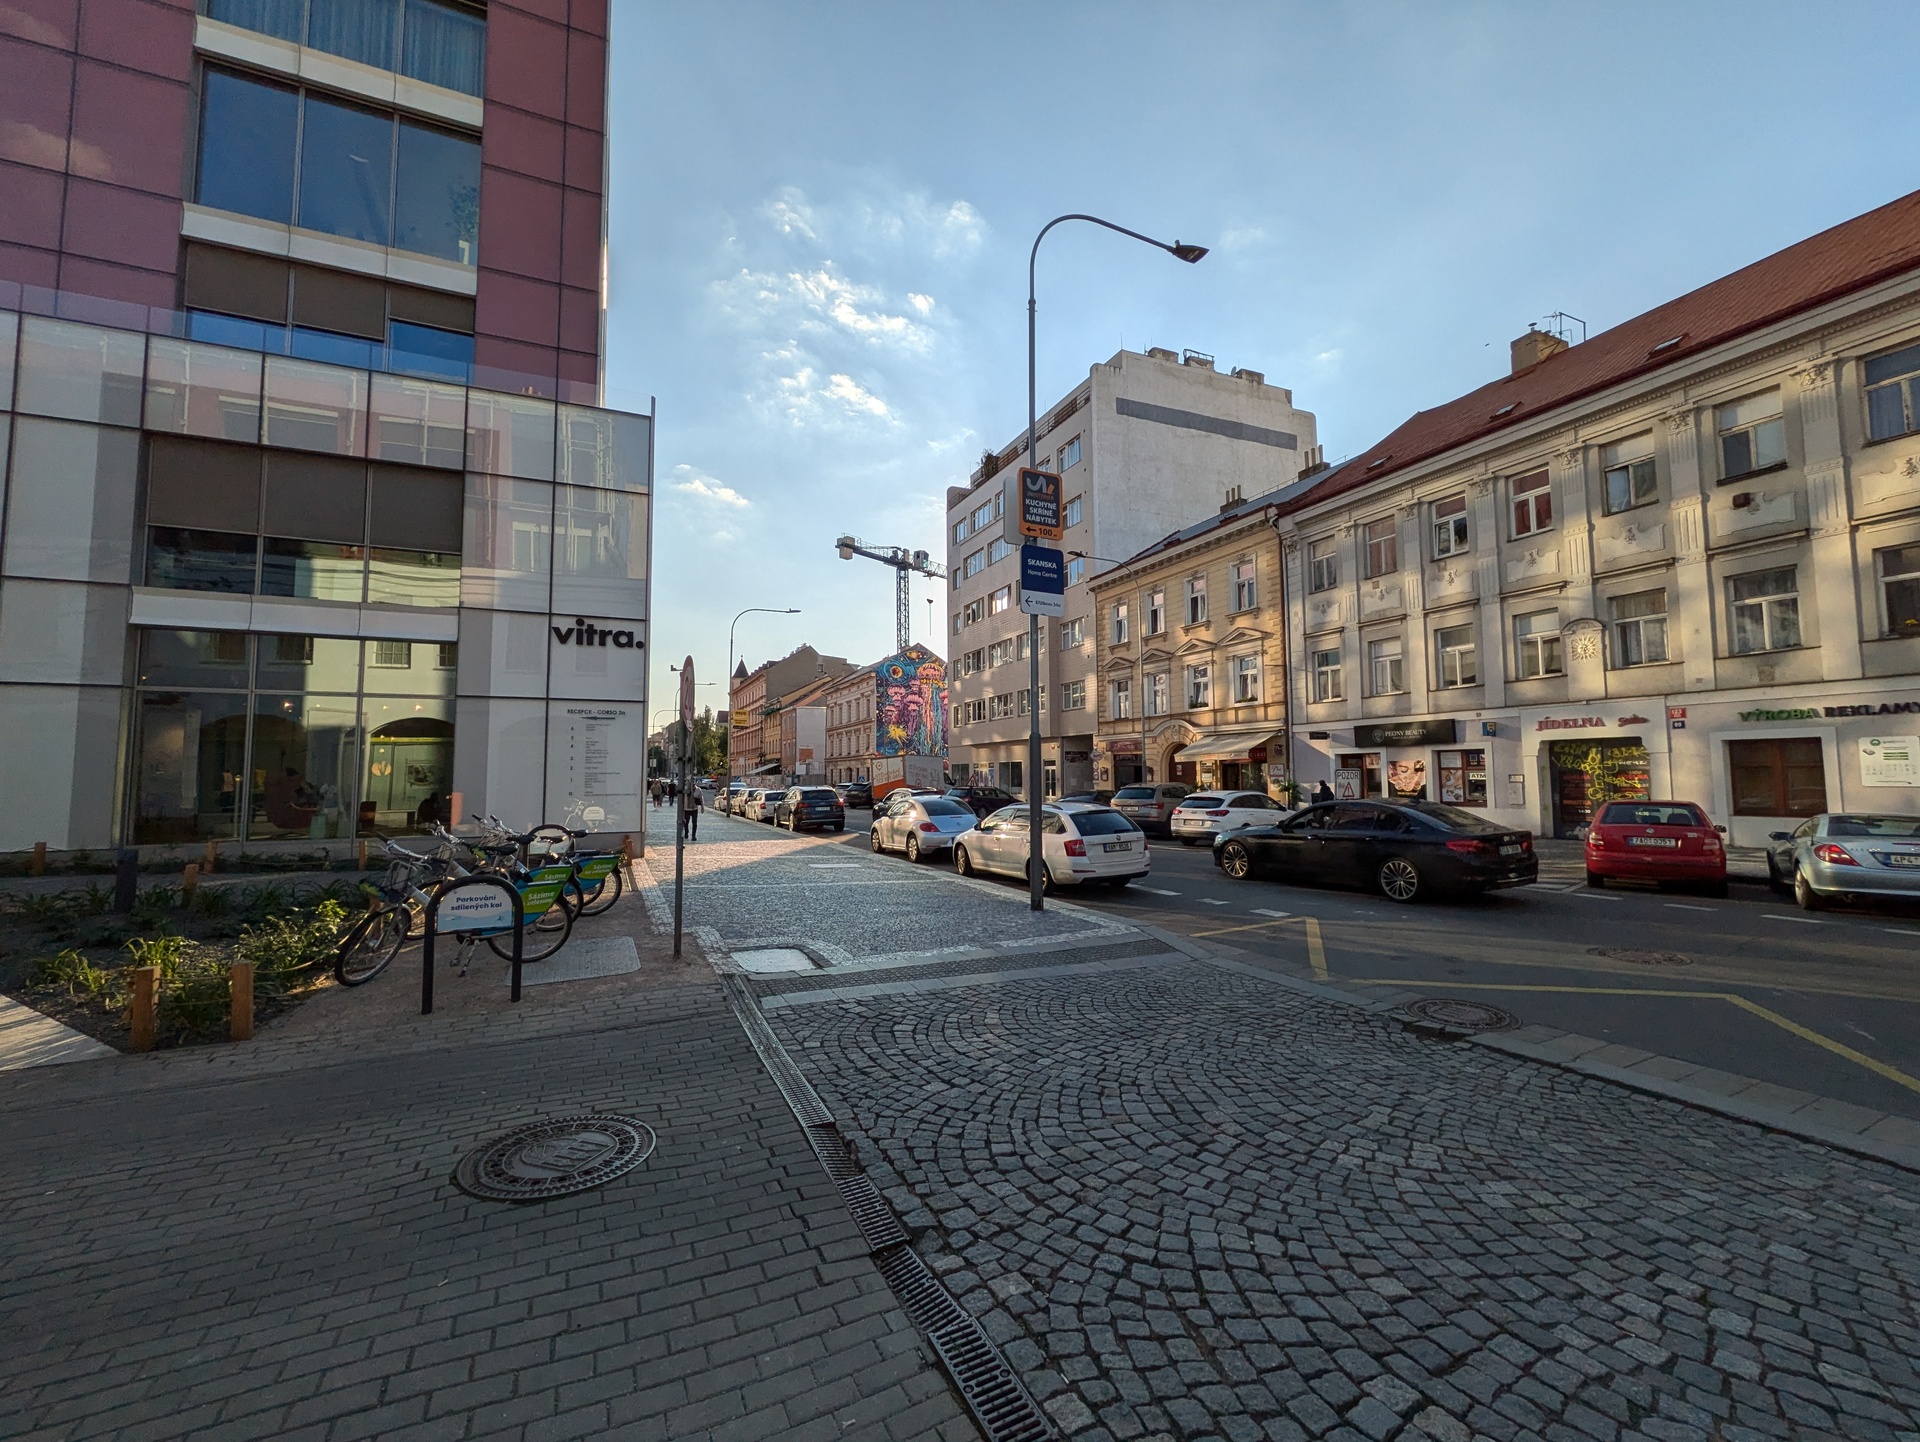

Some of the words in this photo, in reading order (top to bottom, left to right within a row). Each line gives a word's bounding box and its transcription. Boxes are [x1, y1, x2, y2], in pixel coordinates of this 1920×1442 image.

[1025, 498, 1057, 510] KUCHYNĚ
[1026, 514, 1057, 525] NÁBYTEK
[1039, 527, 1053, 537] 100
[1027, 558, 1057, 569] SKANSKA
[1028, 569, 1042, 577] Home
[1042, 571, 1058, 579] Centre
[552, 618, 644, 649] vitra.
[1738, 708, 1815, 722] VÝROBA
[1536, 716, 1606, 731] JÍDELNA
[1337, 772, 1359, 780] POZOR
[456, 894, 496, 903] Parkování
[528, 891, 555, 900] Sázíme
[451, 902, 489, 911] sdílených
